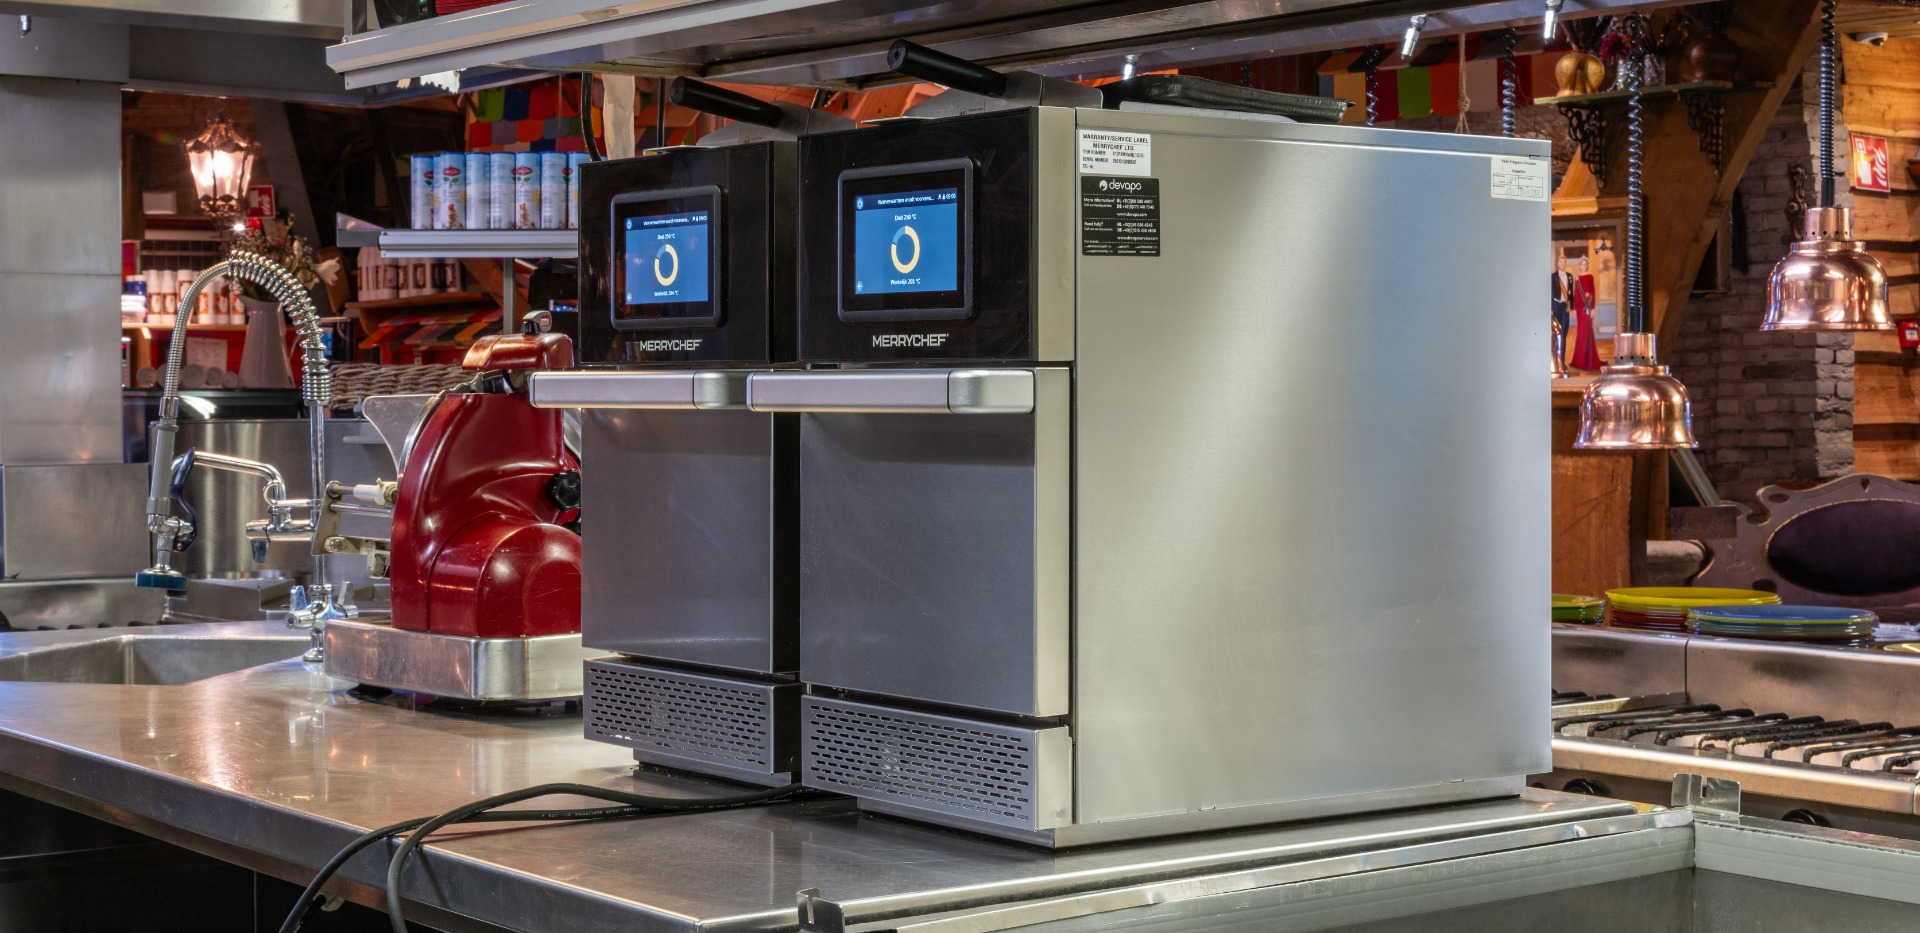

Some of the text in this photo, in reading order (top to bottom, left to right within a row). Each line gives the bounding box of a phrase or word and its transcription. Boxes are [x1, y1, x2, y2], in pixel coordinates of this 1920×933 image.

[1083, 134, 1132, 142] WARRANTY/SERVICE
[1109, 179, 1142, 193] devapo
[640, 340, 700, 351] MERRYCHEF
[873, 334, 946, 348] MERRYCHEF
